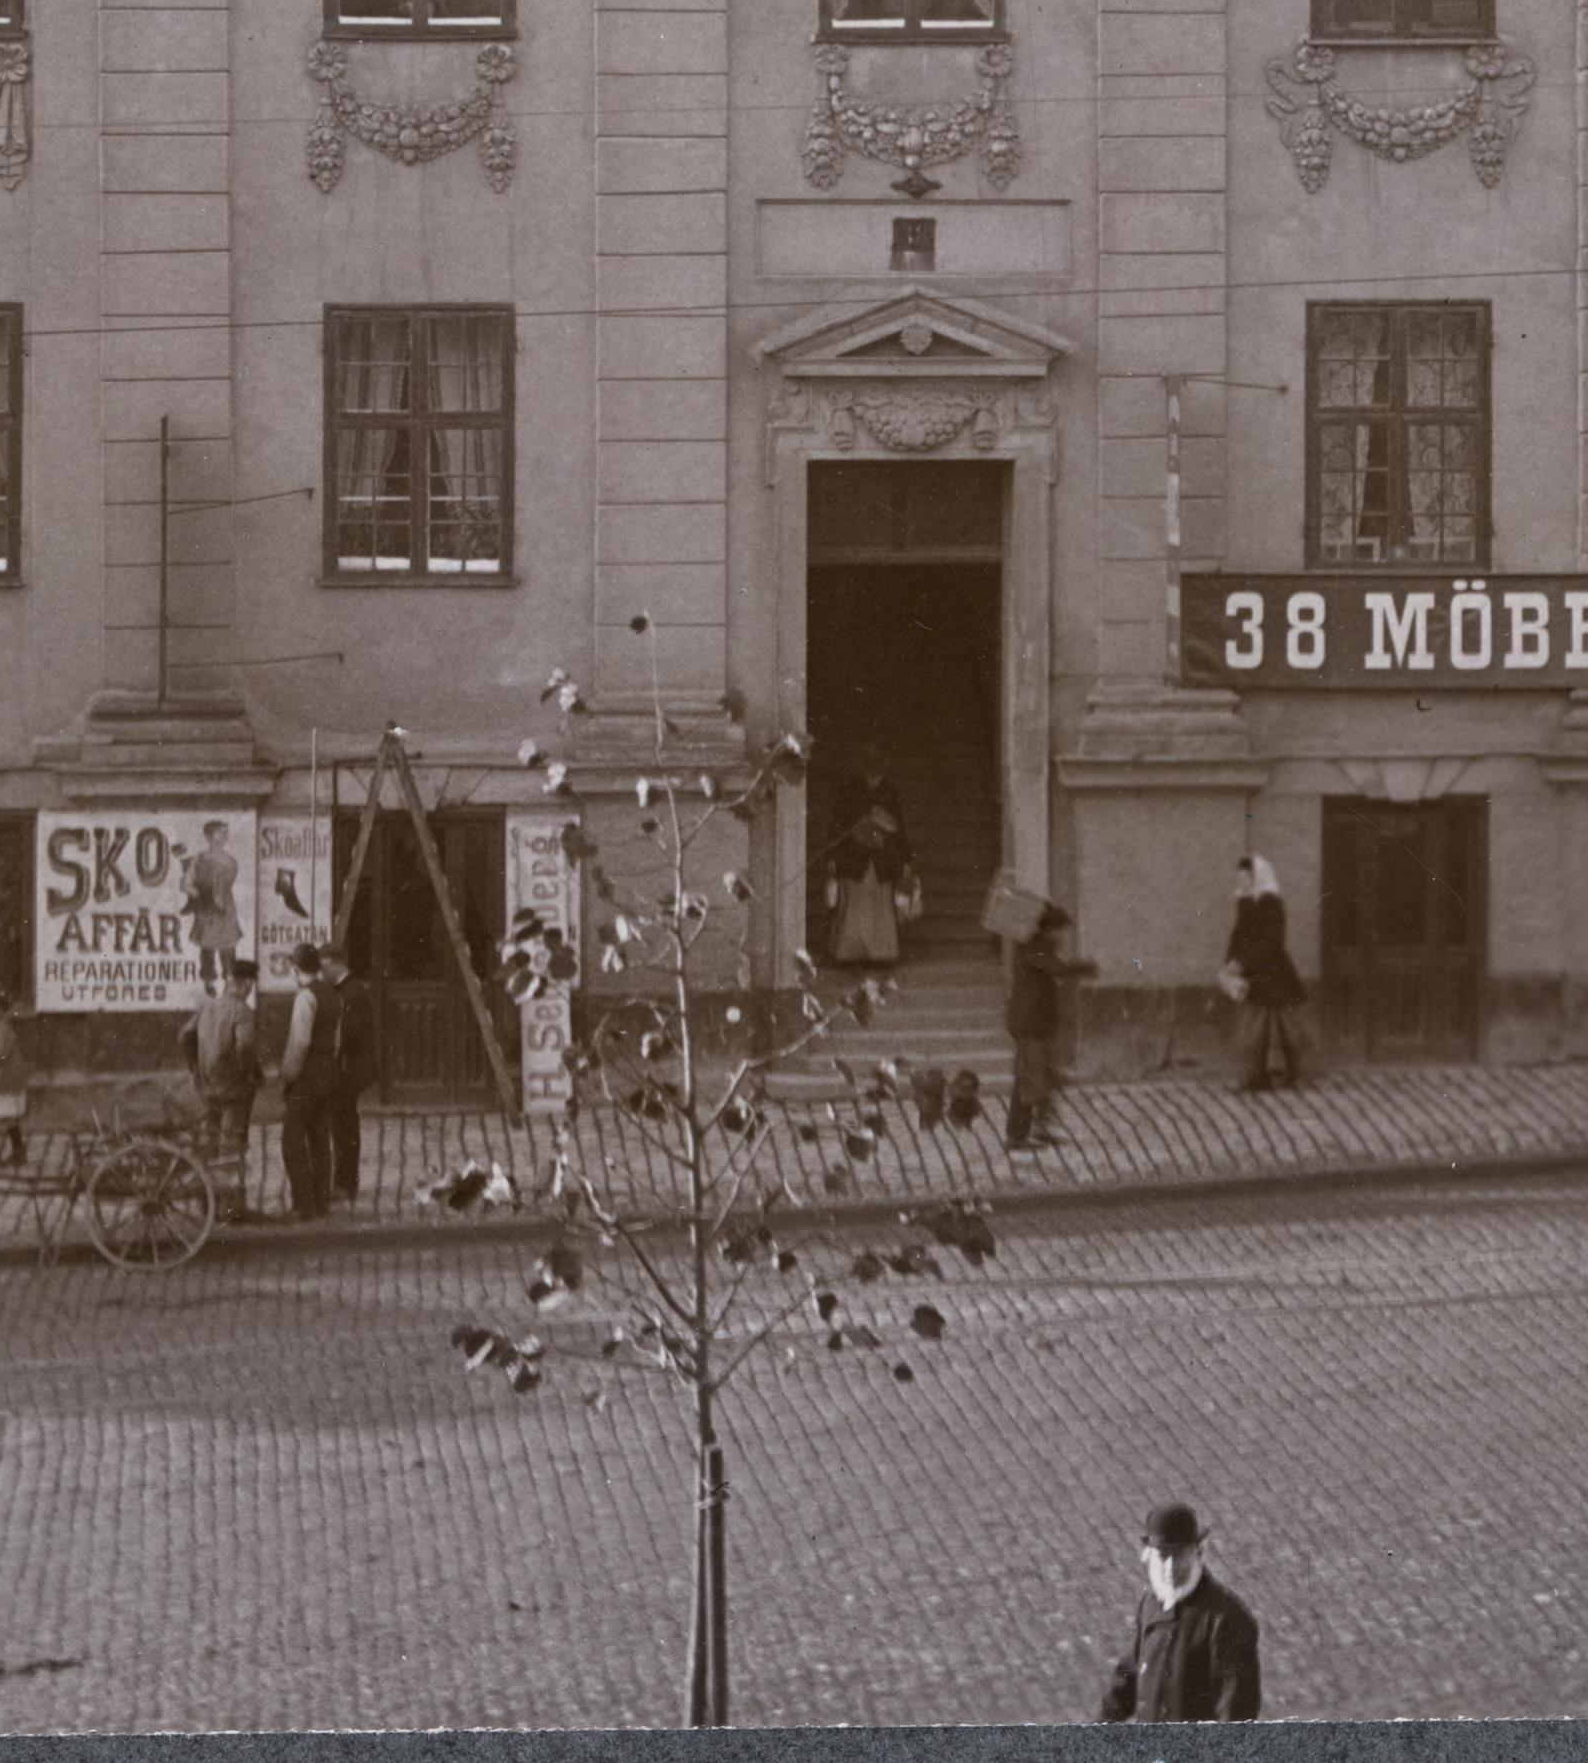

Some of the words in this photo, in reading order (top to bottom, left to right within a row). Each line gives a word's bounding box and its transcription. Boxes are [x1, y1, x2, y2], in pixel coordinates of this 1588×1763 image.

[1224, 591, 1327, 670] 38
[56, 907, 183, 954] AFFÄR
[45, 959, 197, 982] REPARATIONER
